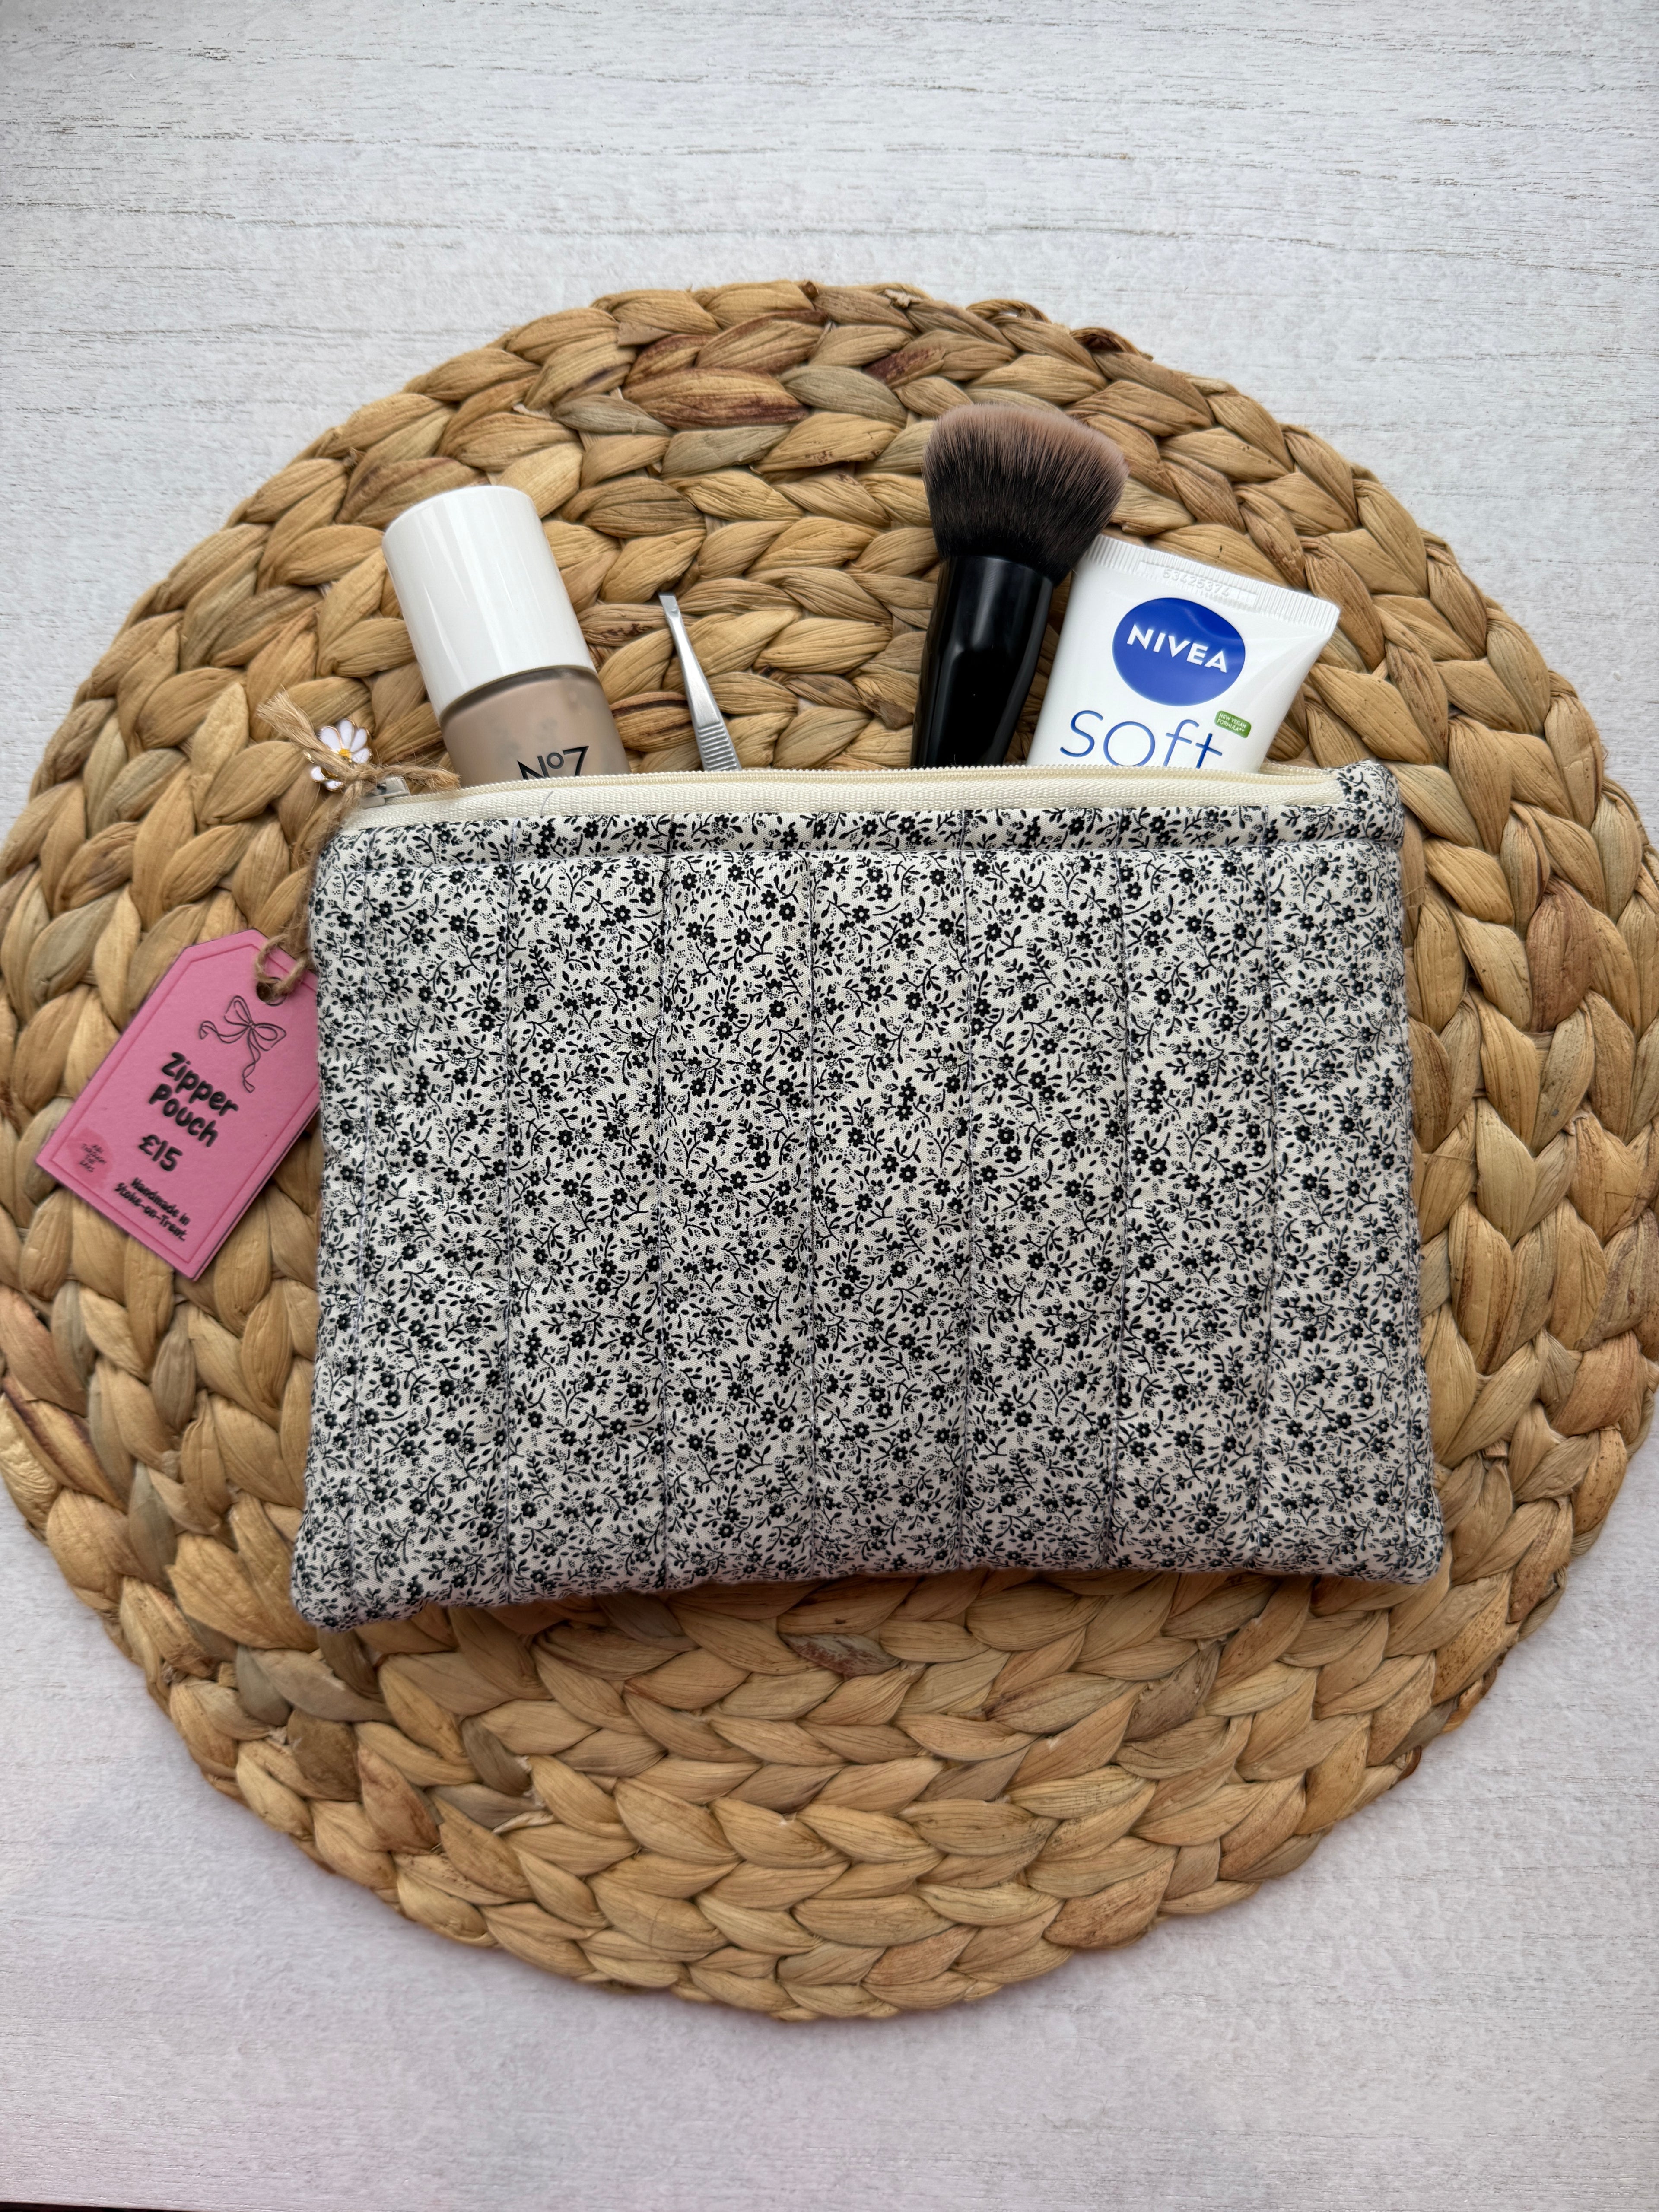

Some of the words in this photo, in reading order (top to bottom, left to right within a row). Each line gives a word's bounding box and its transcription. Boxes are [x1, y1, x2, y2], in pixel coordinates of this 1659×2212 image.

[1126, 624, 1227, 673] NIVEA
[1059, 710, 1223, 769] Soft
[1219, 713, 1231, 721] NEW
[1231, 718, 1246, 729] VEGAN
[162, 1052, 239, 1116] Zipper
[149, 1083, 218, 1147] Pouch
[138, 1134, 183, 1172] £15
[131, 1177, 179, 1218] Handmade
